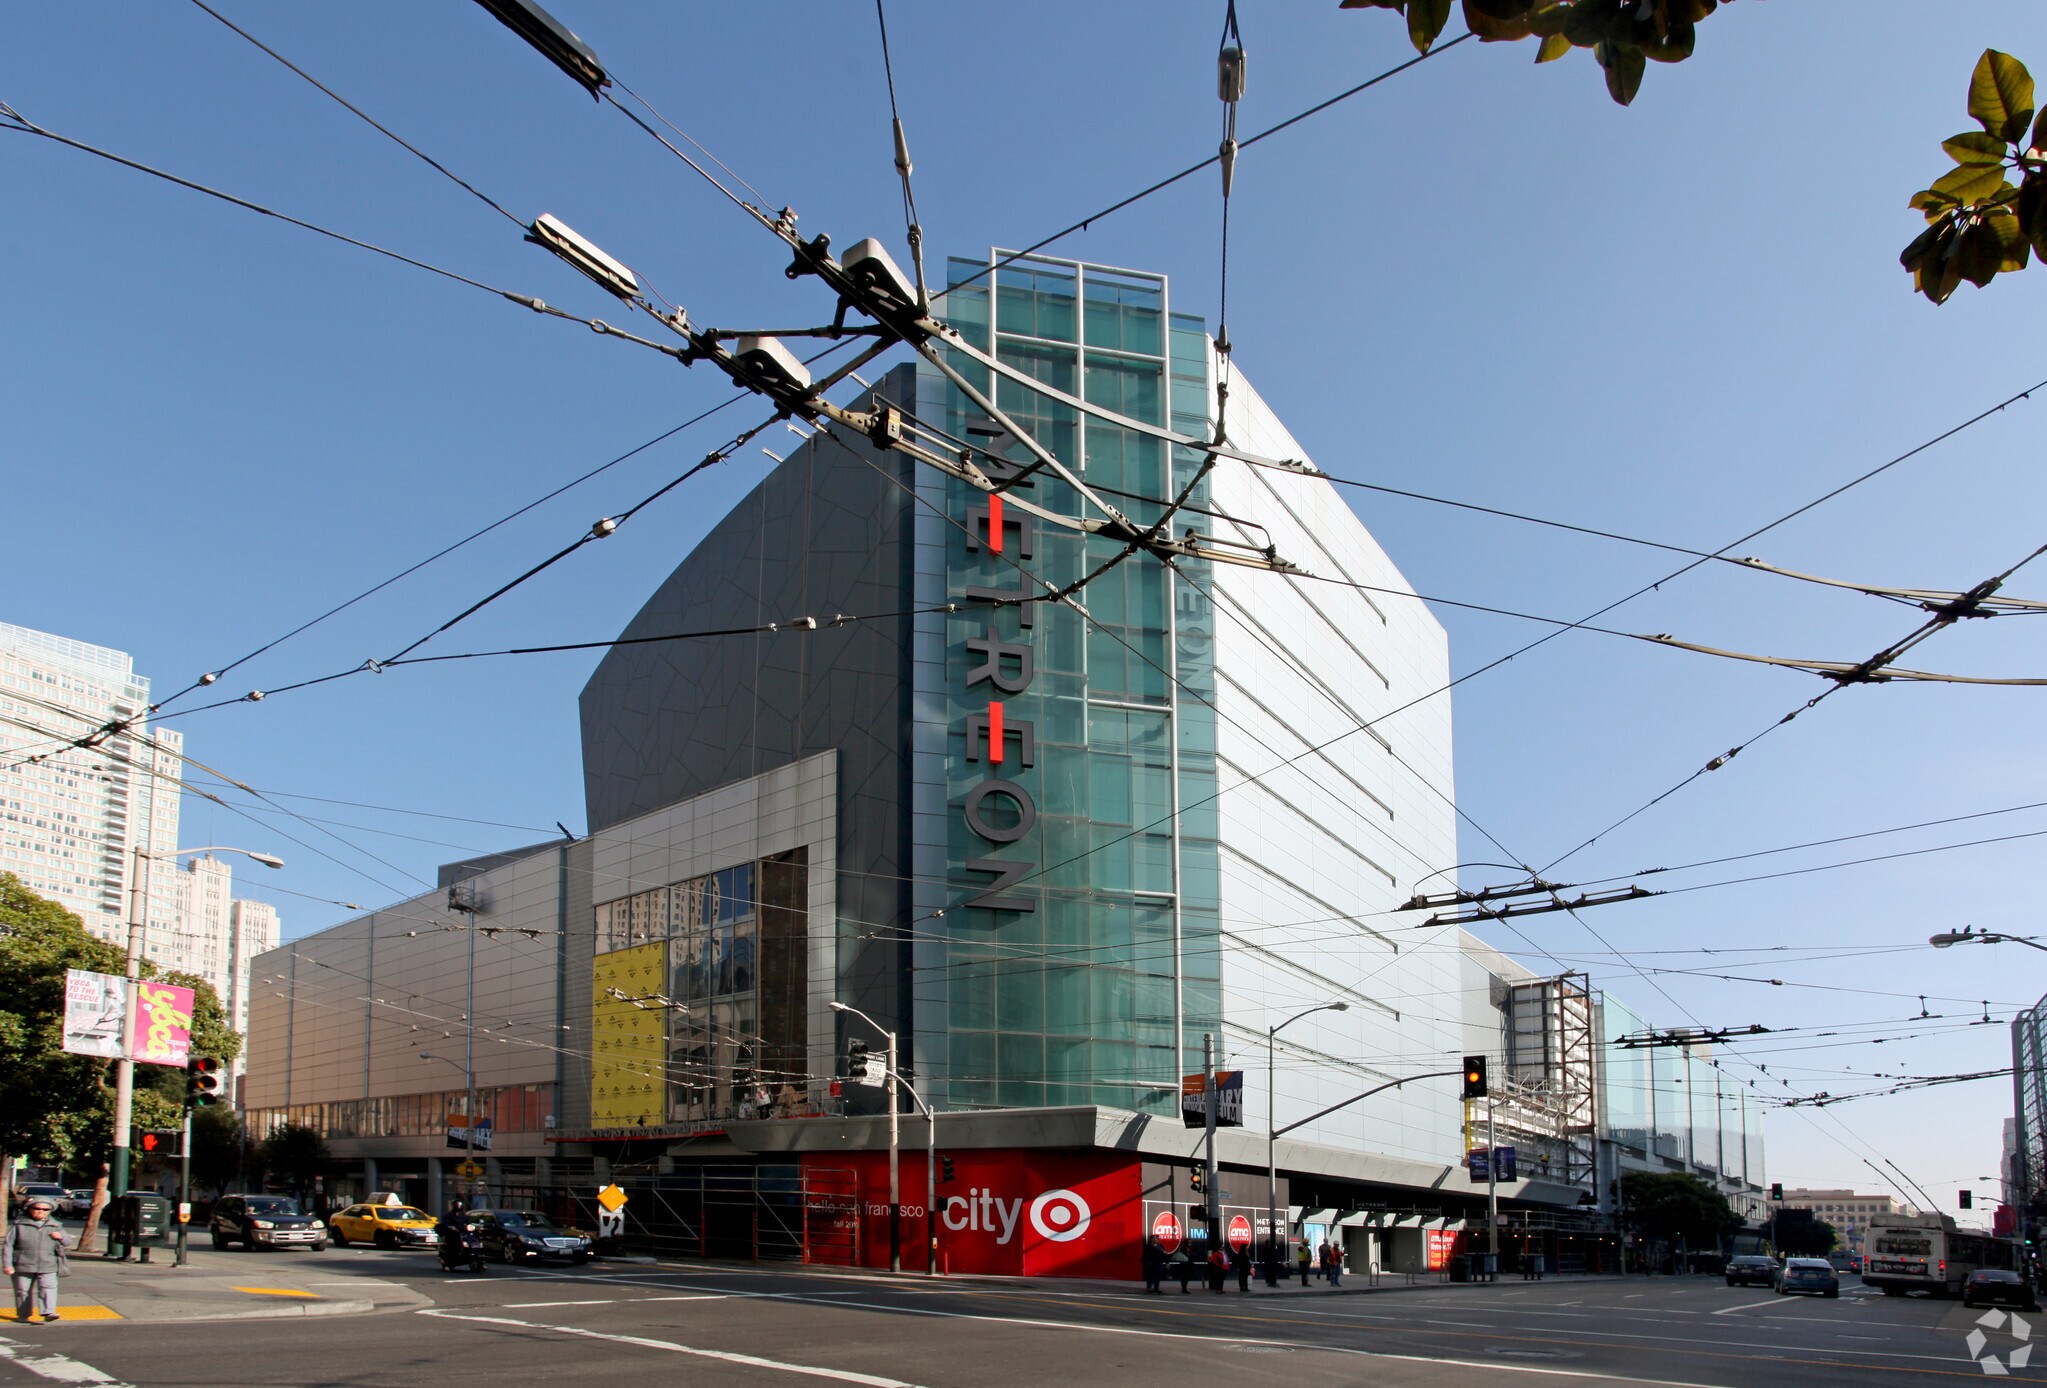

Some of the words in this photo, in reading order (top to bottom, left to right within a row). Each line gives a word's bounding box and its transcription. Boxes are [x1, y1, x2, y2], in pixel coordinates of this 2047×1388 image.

[964, 418, 1036, 914] METREON
[69, 979, 90, 987] YBCA
[81, 987, 97, 995] THE
[68, 993, 100, 1003] RESCUE
[807, 1199, 836, 1214] hello
[865, 1201, 924, 1217] fransco
[943, 1188, 1023, 1244] city
[1256, 1218, 1285, 1226] METEON
[1190, 1228, 1209, 1239] IM
[1230, 1228, 1249, 1237] amc
[1256, 1226, 1285, 1235] ENTRNCE
